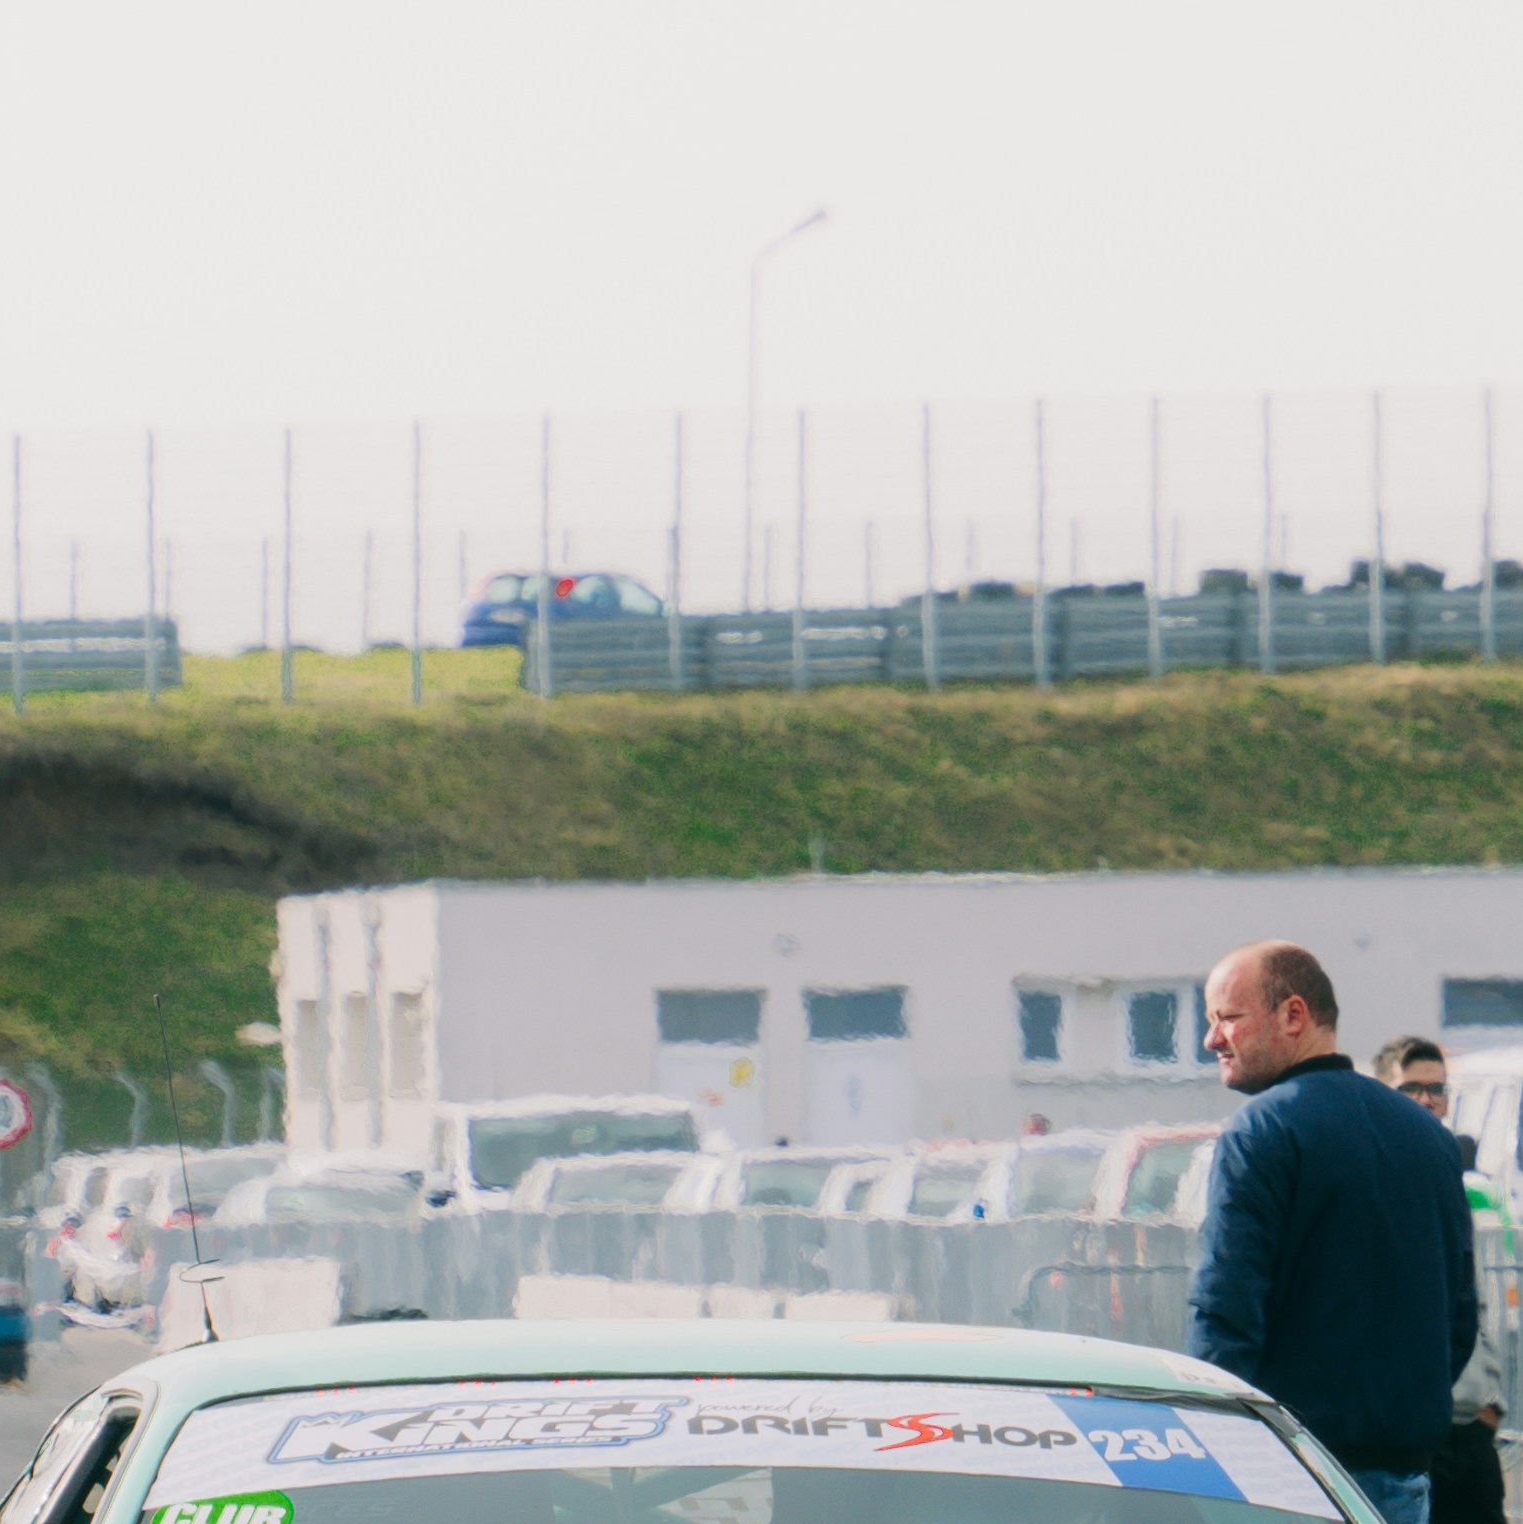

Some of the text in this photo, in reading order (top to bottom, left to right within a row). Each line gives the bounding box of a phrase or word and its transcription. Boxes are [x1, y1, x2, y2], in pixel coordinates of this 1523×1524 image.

[428, 1398, 665, 1421] DRIFT
[697, 1395, 844, 1417] powered by
[335, 1439, 526, 1460] INTERNATIONAL
[1087, 1427, 1207, 1463] 234
